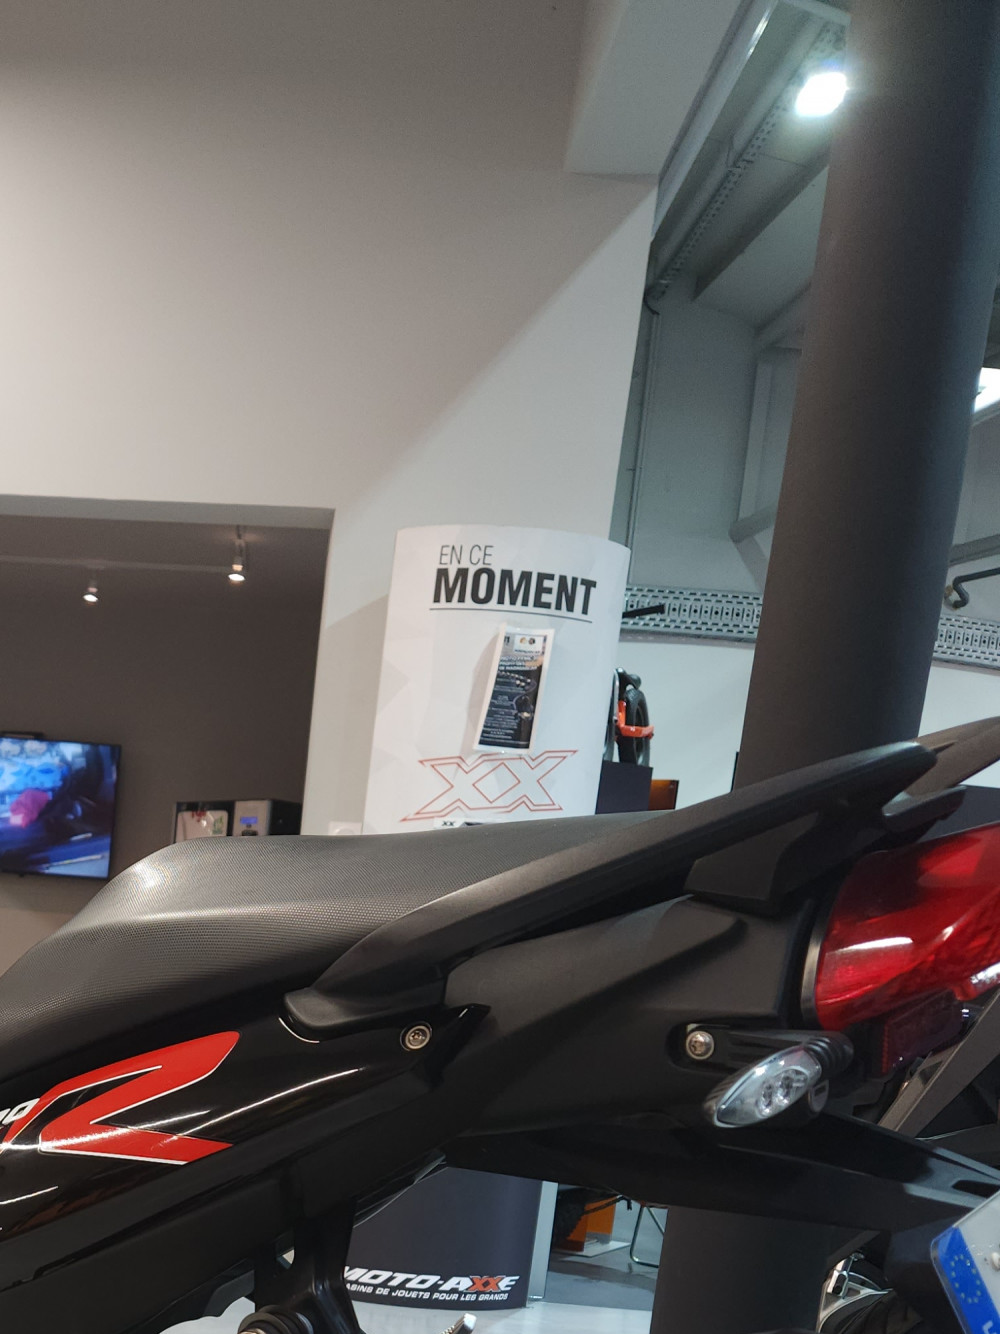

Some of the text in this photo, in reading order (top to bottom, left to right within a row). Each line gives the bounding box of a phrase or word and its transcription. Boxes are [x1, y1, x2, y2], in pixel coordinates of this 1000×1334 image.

[439, 544, 494, 566] EN CE
[432, 567, 597, 616] MOMENT
[375, 1286, 391, 1296] DE
[391, 1289, 431, 1300] JOUETS
[432, 1291, 459, 1301] POUR
[460, 1293, 478, 1301] LES
[478, 1293, 509, 1301] GRANDS
